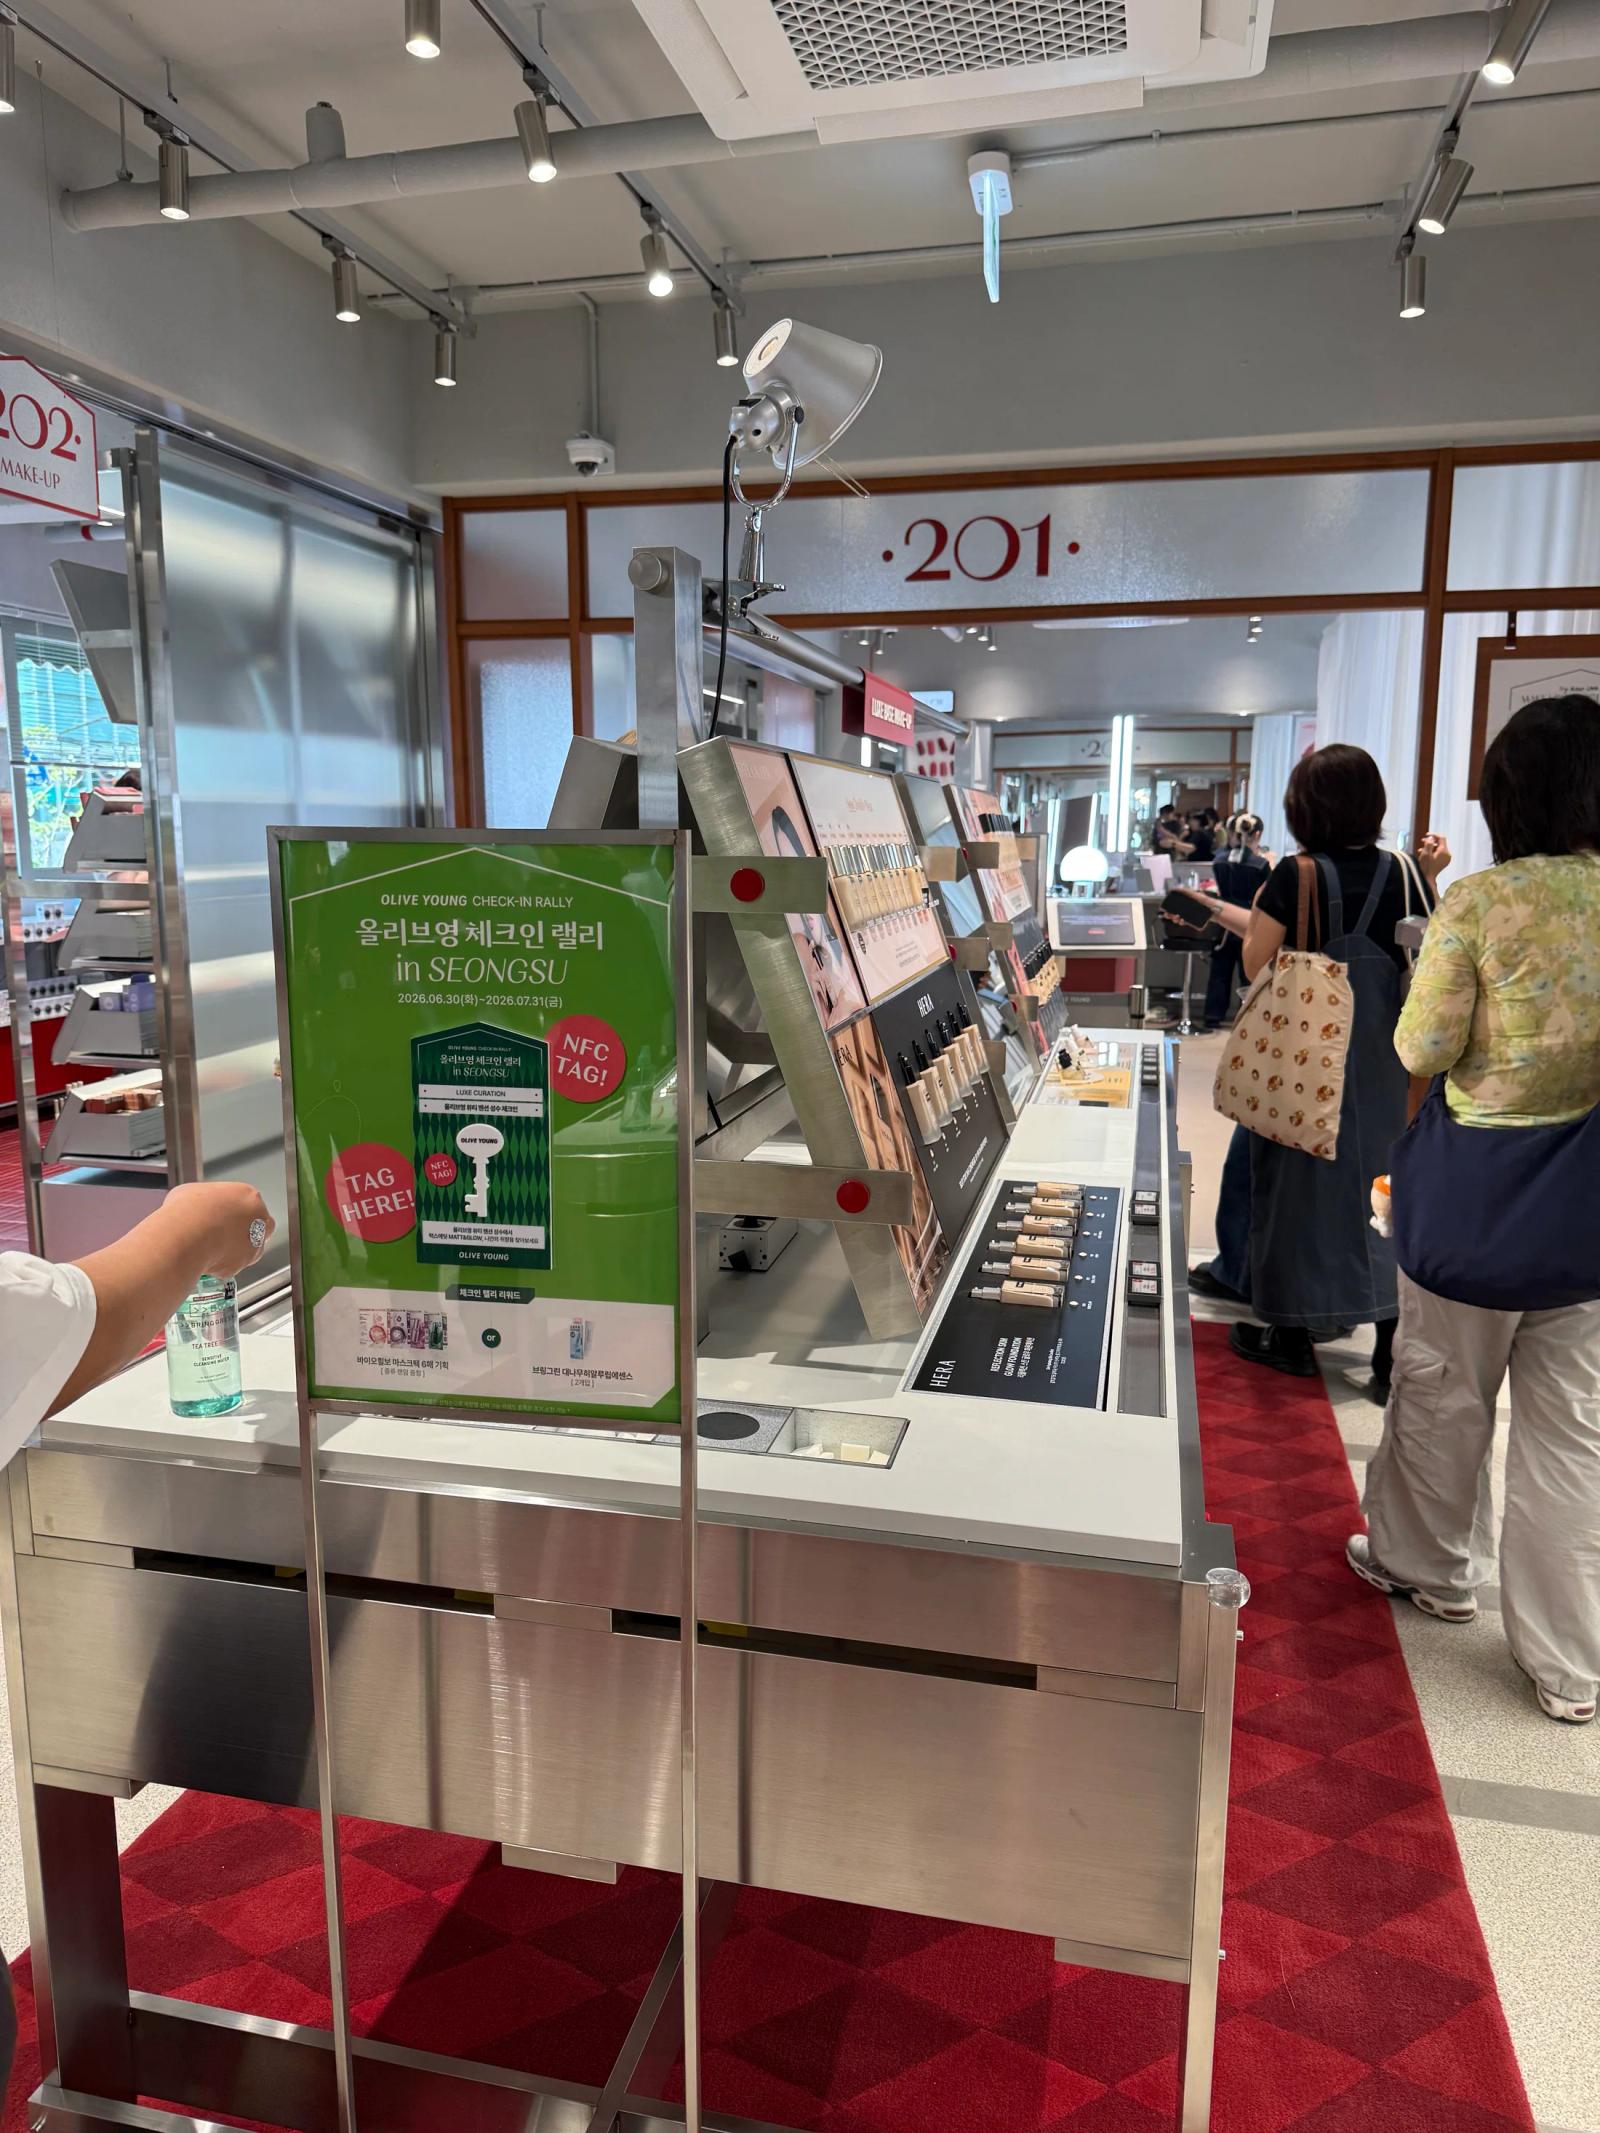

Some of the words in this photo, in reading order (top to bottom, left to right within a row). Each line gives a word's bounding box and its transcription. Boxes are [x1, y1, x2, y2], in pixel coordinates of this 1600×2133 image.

[0, 457, 60, 489] MAKE-UP
[381, 894, 419, 905] OLIVE
[422, 895, 467, 906] YOUNG
[472, 896, 532, 907] CHECK-IN
[535, 897, 573, 908] RALLY
[355, 918, 459, 948] 올리브영
[465, 919, 544, 949] 체크인
[551, 921, 603, 950] 랠리
[396, 953, 420, 982] in
[428, 956, 568, 985] SEONGSU
[917, 993, 935, 1018] HERA
[563, 1032, 609, 1061] NFC
[440, 1054, 474, 1065] 올리브영
[476, 1056, 501, 1066] 체크인
[453, 1065, 461, 1076] in
[463, 1067, 509, 1078] SEONGSU
[556, 1055, 608, 1086] TAG!
[430, 1160, 449, 1170] NFC
[432, 1168, 453, 1179] TAG!
[345, 1167, 395, 1194] TAG
[342, 1189, 415, 1222] HERE!
[458, 1251, 480, 1259] OLIVE
[483, 1252, 509, 1261] YOUNG
[459, 1288, 481, 1297] 체크인
[499, 1290, 520, 1300] 리워드
[486, 1334, 497, 1342] or
[532, 1366, 560, 1376] 브링그린
[929, 1360, 957, 1387] HERA
